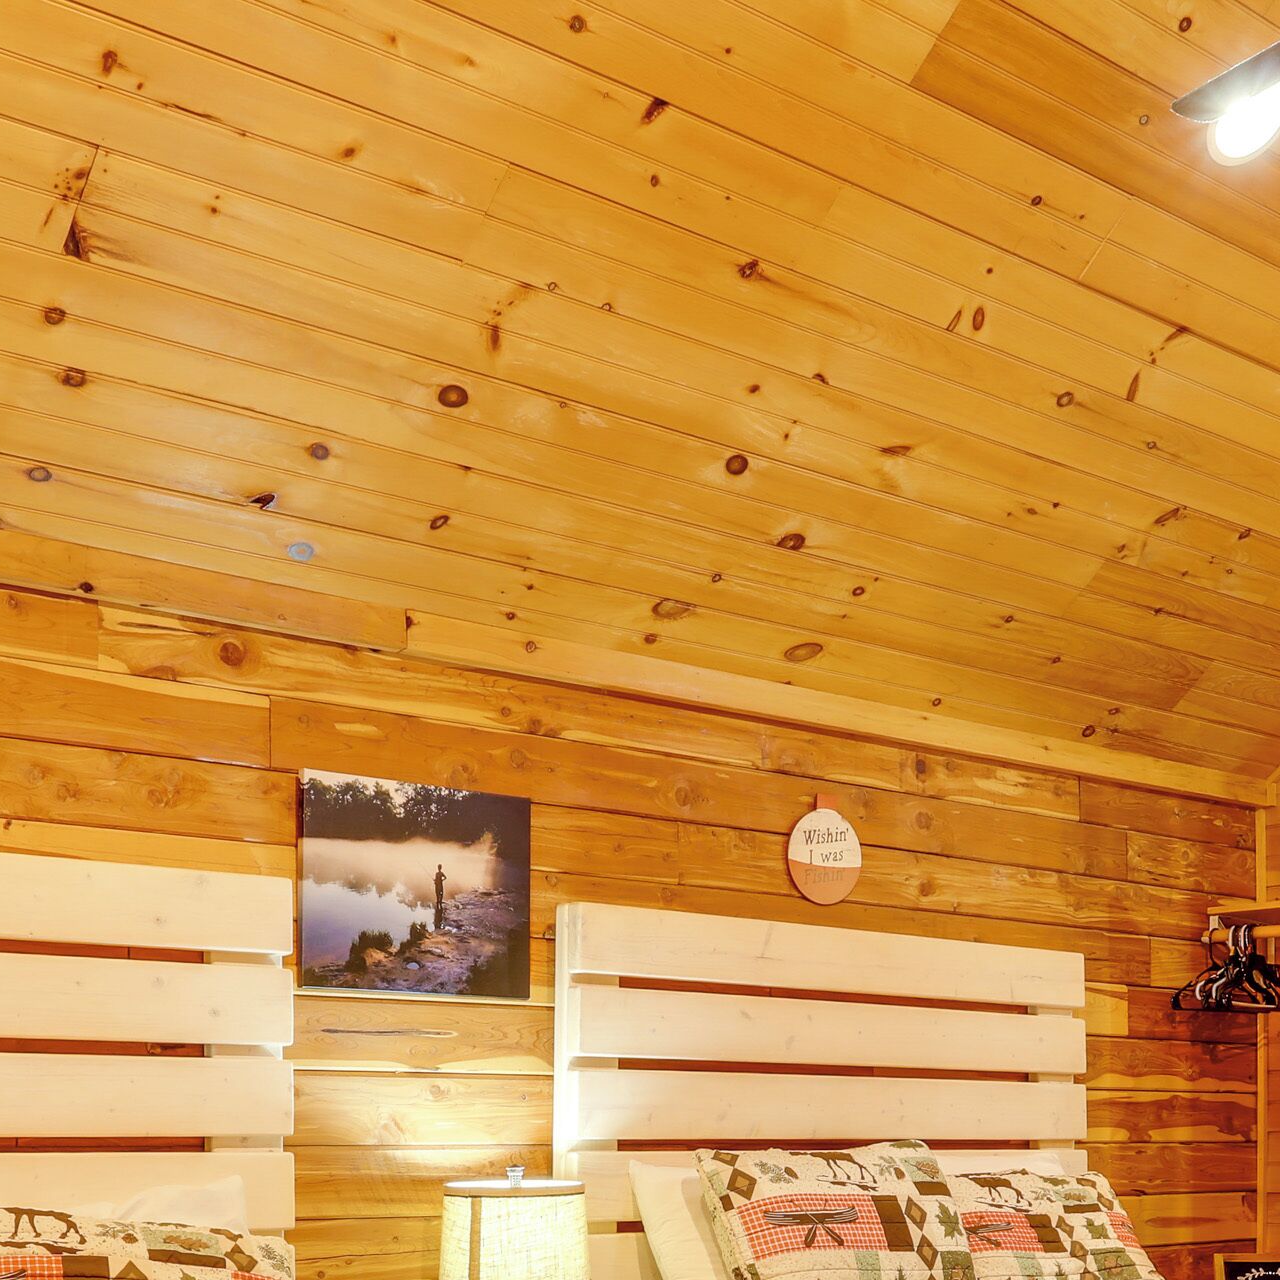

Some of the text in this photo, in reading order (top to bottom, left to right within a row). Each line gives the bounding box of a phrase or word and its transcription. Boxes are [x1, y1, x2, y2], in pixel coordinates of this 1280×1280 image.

[803, 827, 849, 846] Wishin'
[809, 849, 844, 865] I was
